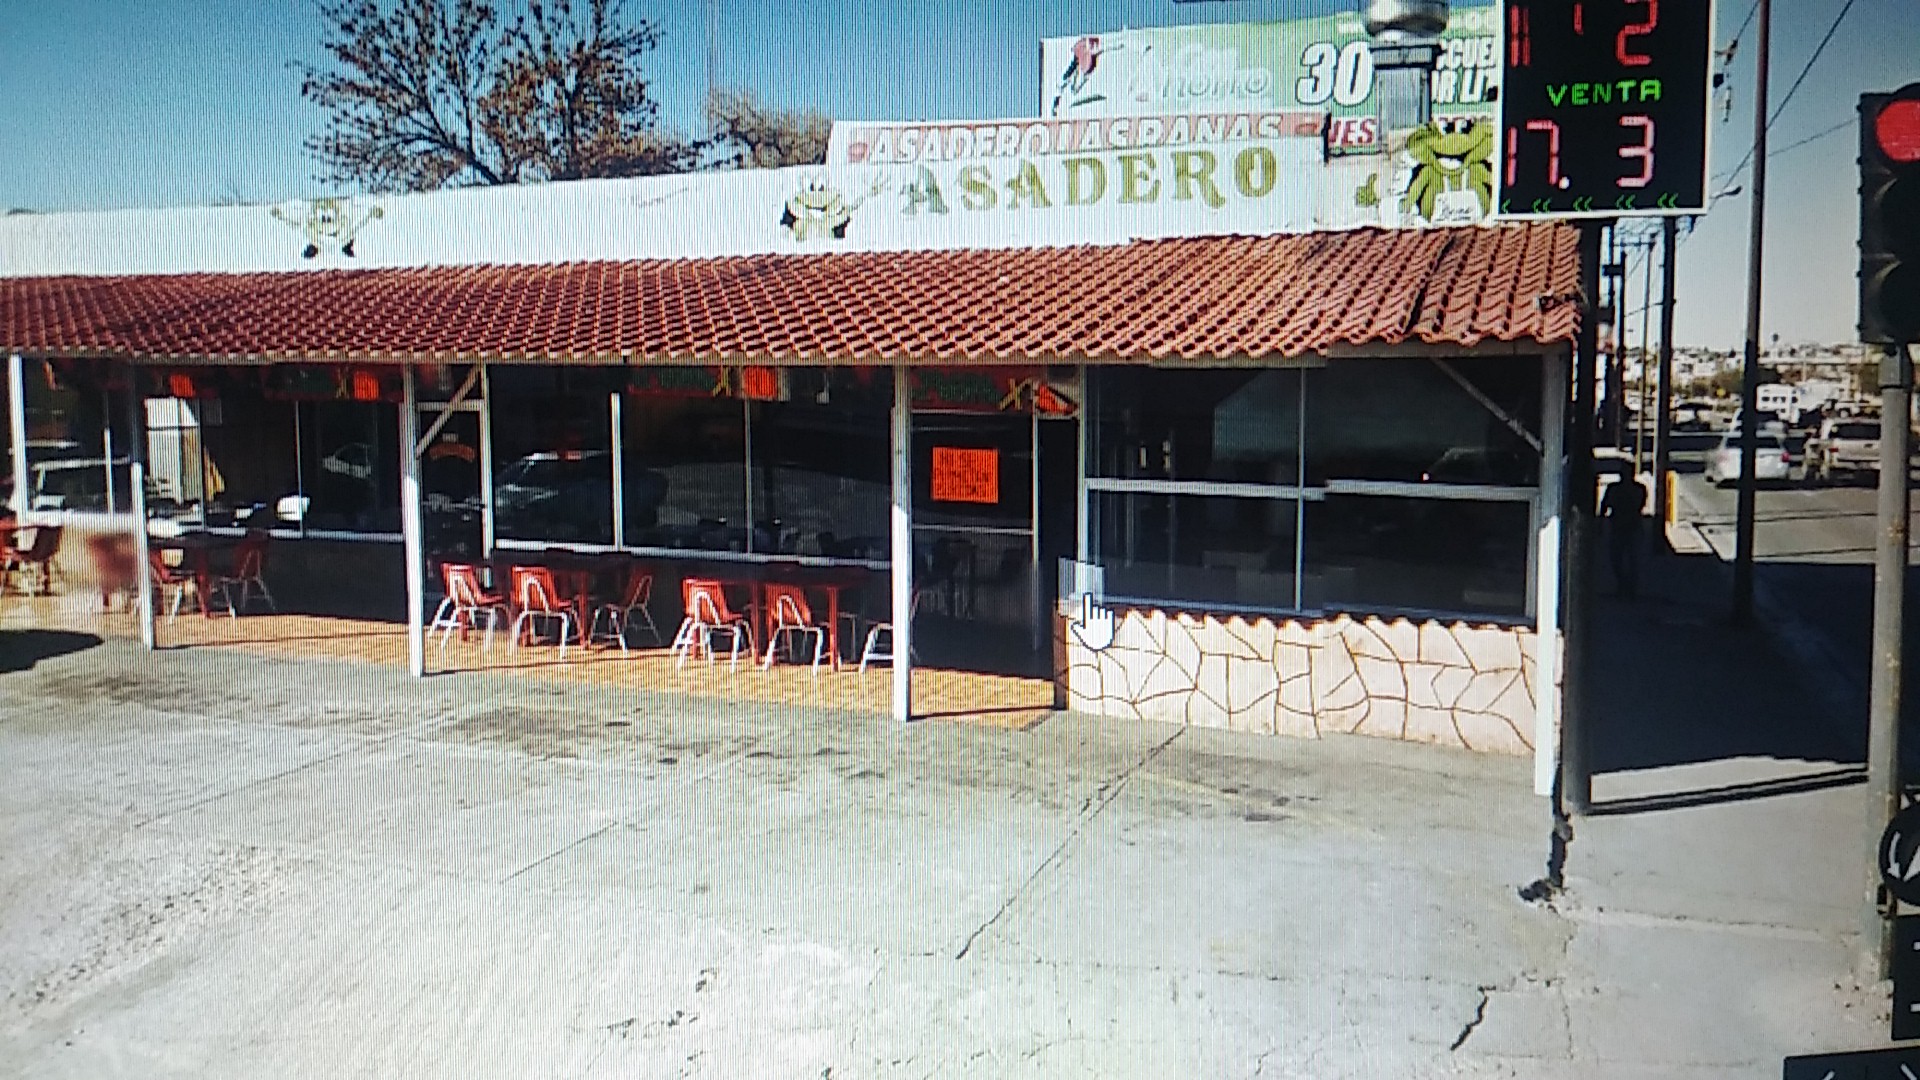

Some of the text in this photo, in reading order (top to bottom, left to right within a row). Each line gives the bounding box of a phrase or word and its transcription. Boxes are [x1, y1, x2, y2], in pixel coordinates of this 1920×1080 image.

[1295, 40, 1375, 106] 30
[1546, 79, 1663, 107] VENTA
[902, 146, 1277, 216] ASADERO
